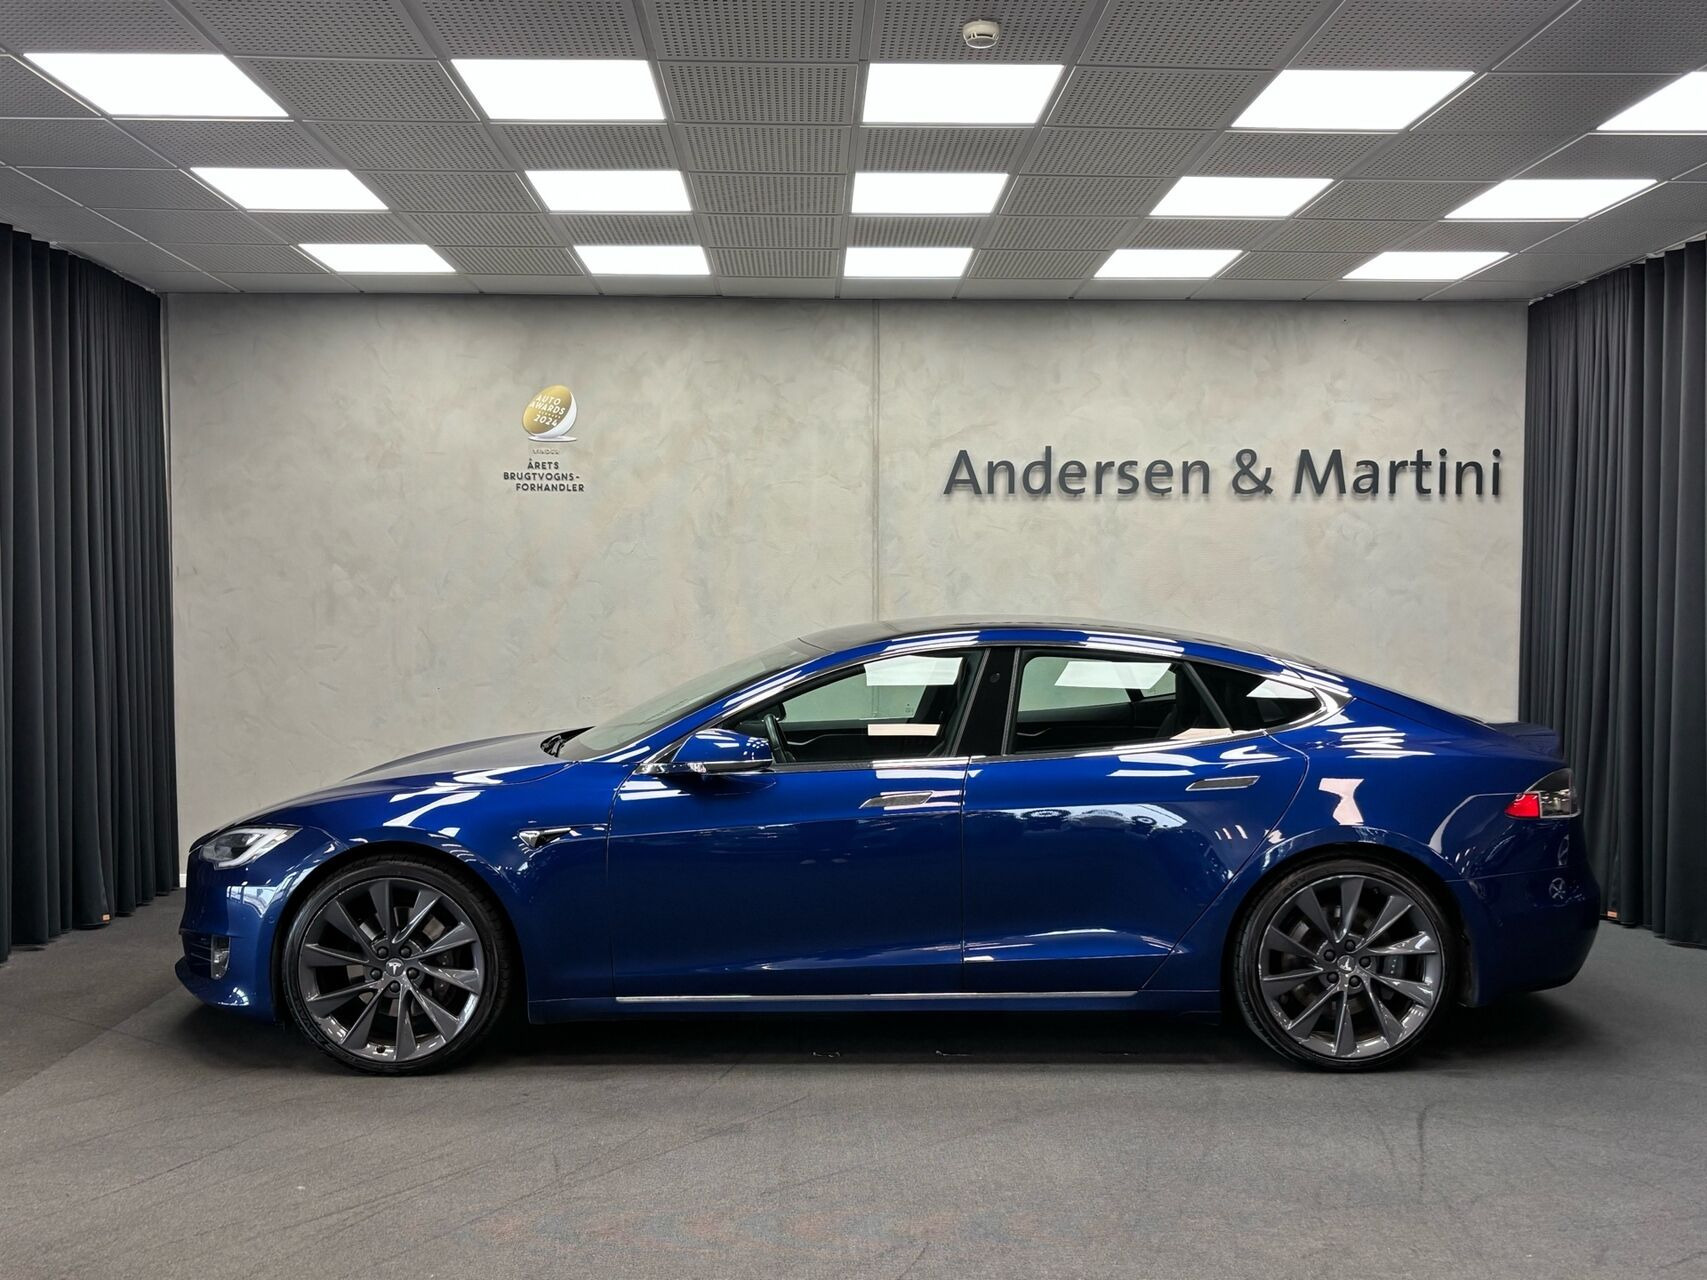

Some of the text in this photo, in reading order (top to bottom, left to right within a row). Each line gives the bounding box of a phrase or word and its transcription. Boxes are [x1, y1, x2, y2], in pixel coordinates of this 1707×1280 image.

[536, 394, 561, 406] AUTO
[529, 400, 566, 415] AWARDS
[534, 414, 559, 427] 2024
[527, 458, 559, 470] ÅRETS
[503, 472, 580, 481] BRUGTVOGNS-
[943, 445, 1501, 496] Andersen & Martini
[516, 483, 585, 492] FORHANDLER
